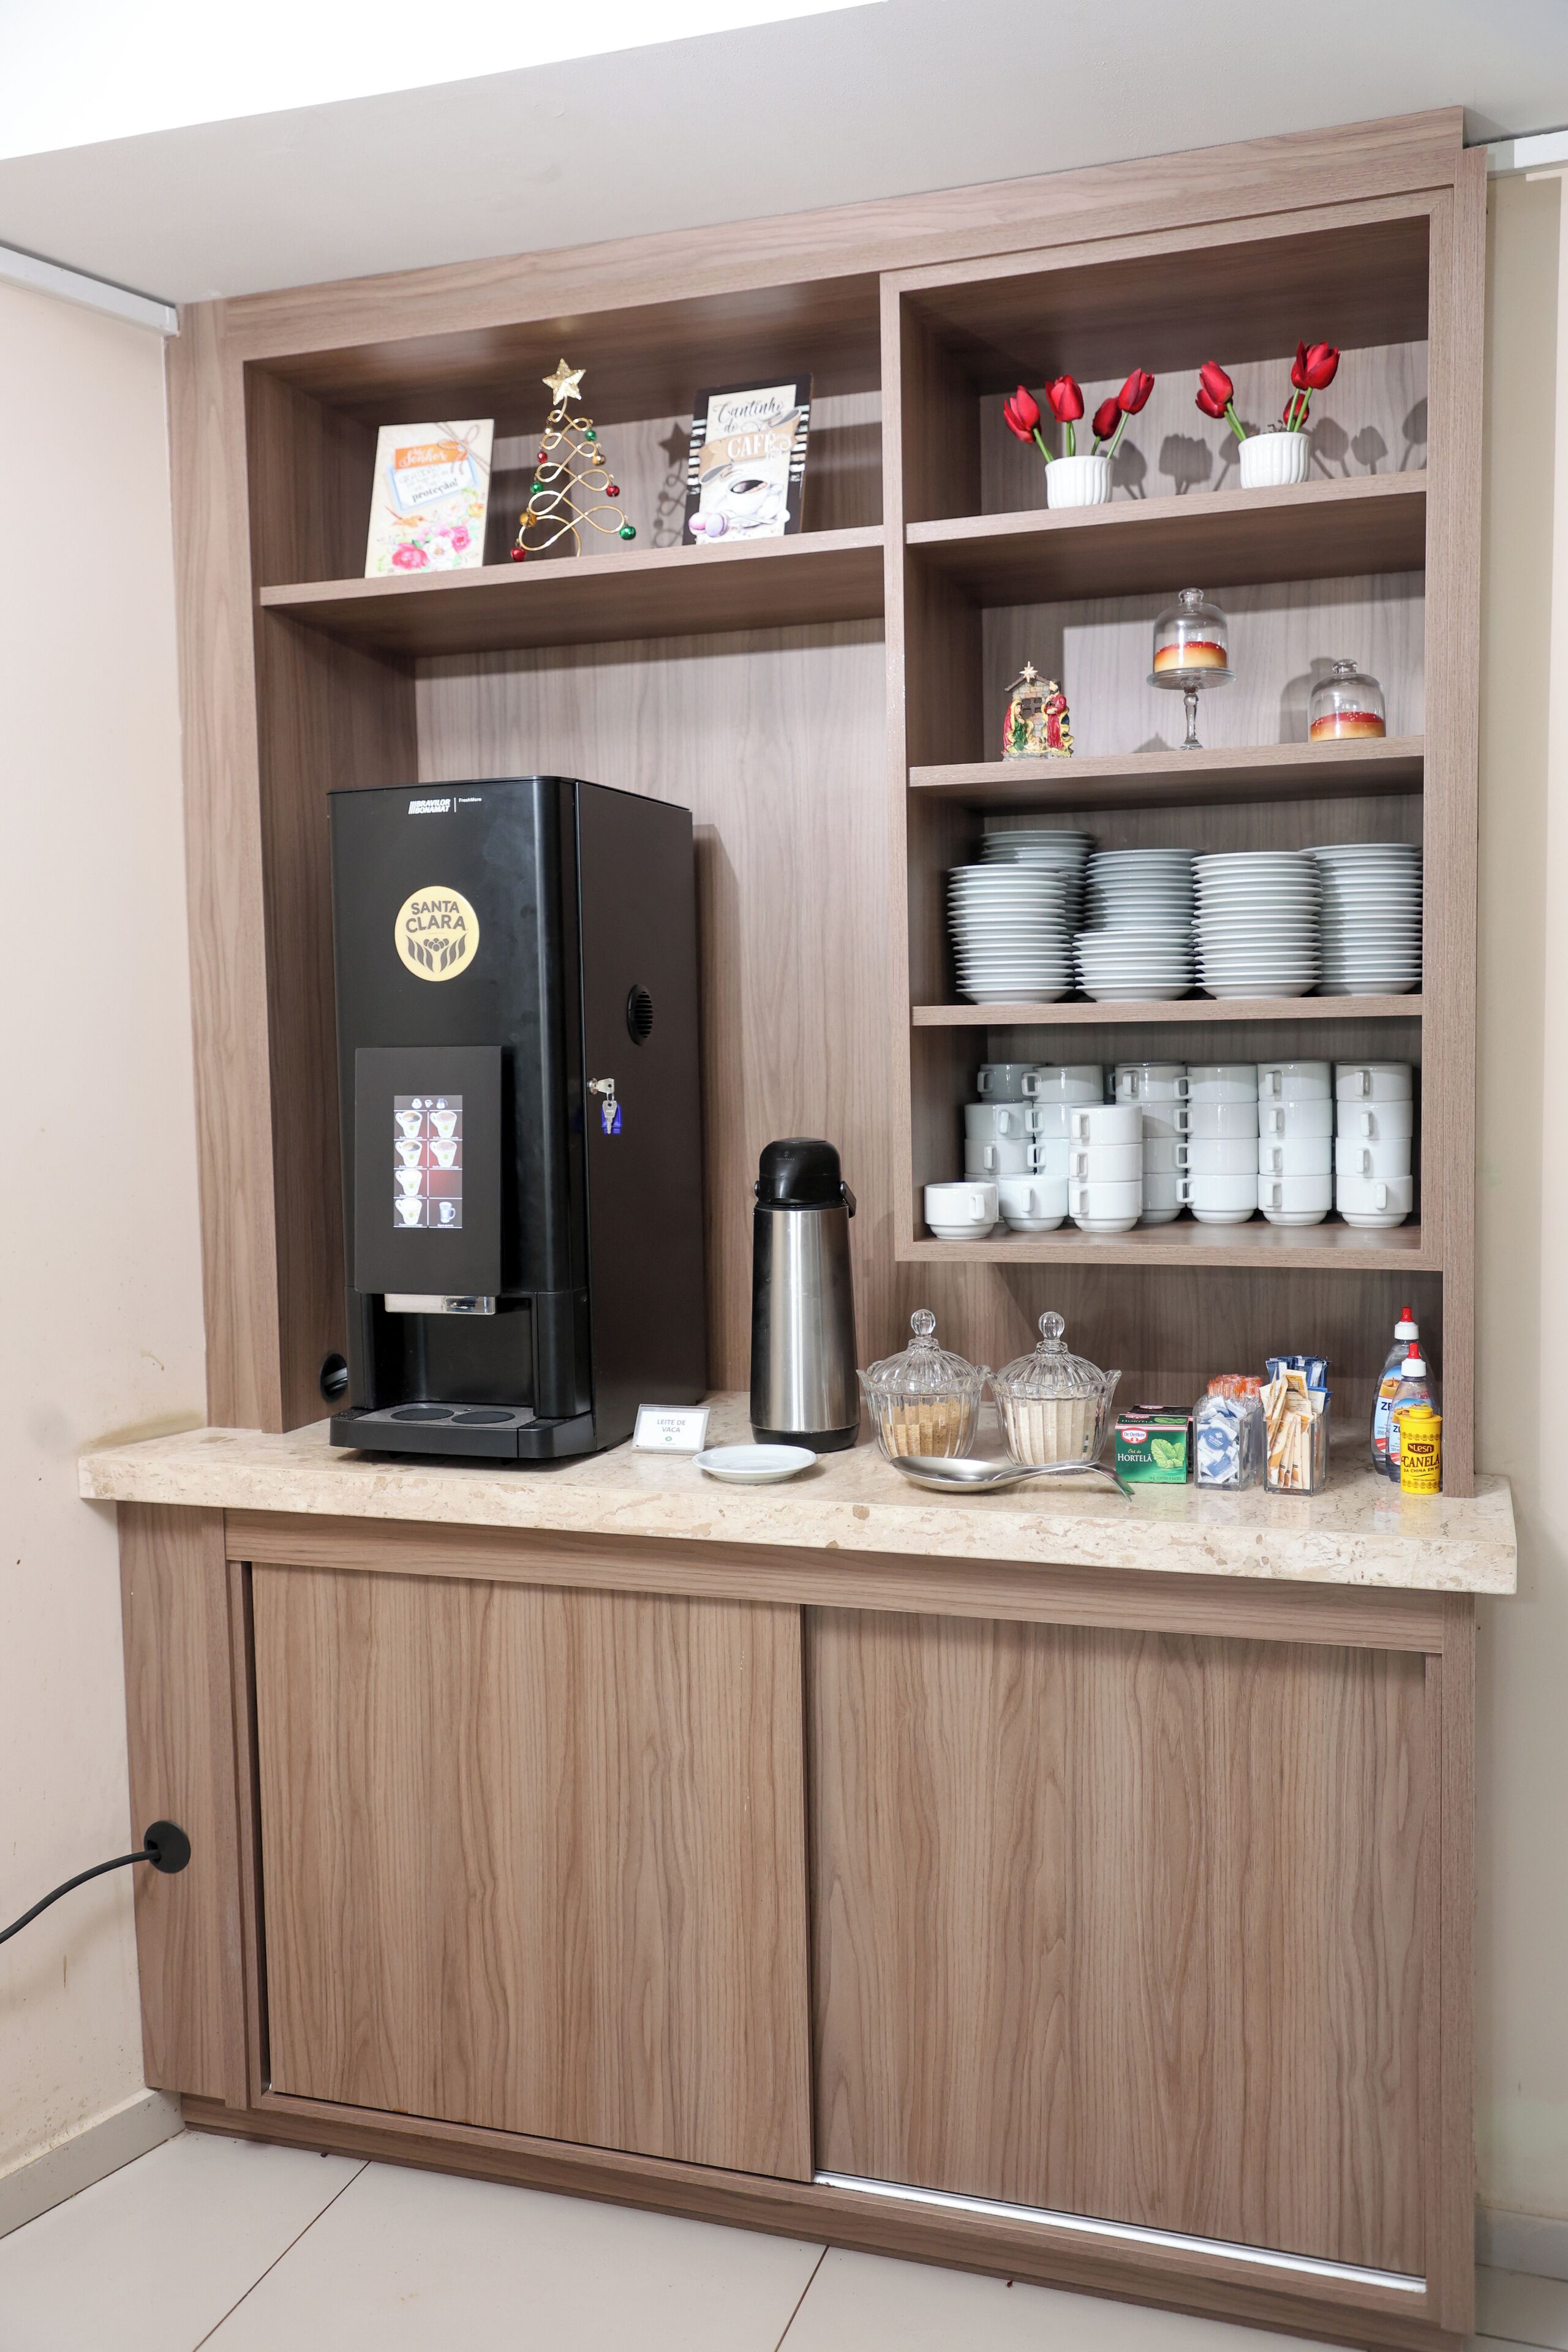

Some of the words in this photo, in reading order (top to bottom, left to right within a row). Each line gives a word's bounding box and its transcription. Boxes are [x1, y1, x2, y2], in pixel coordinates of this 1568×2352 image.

[713, 397, 783, 423] Cantinho
[412, 478, 458, 503] proteção!
[415, 805, 450, 814] BONAMAT
[410, 900, 459, 915] SANTA
[405, 914, 466, 933] CLARA
[1117, 1453, 1152, 1462] HORTELÃ
[1401, 1453, 1440, 1468] CANELA
